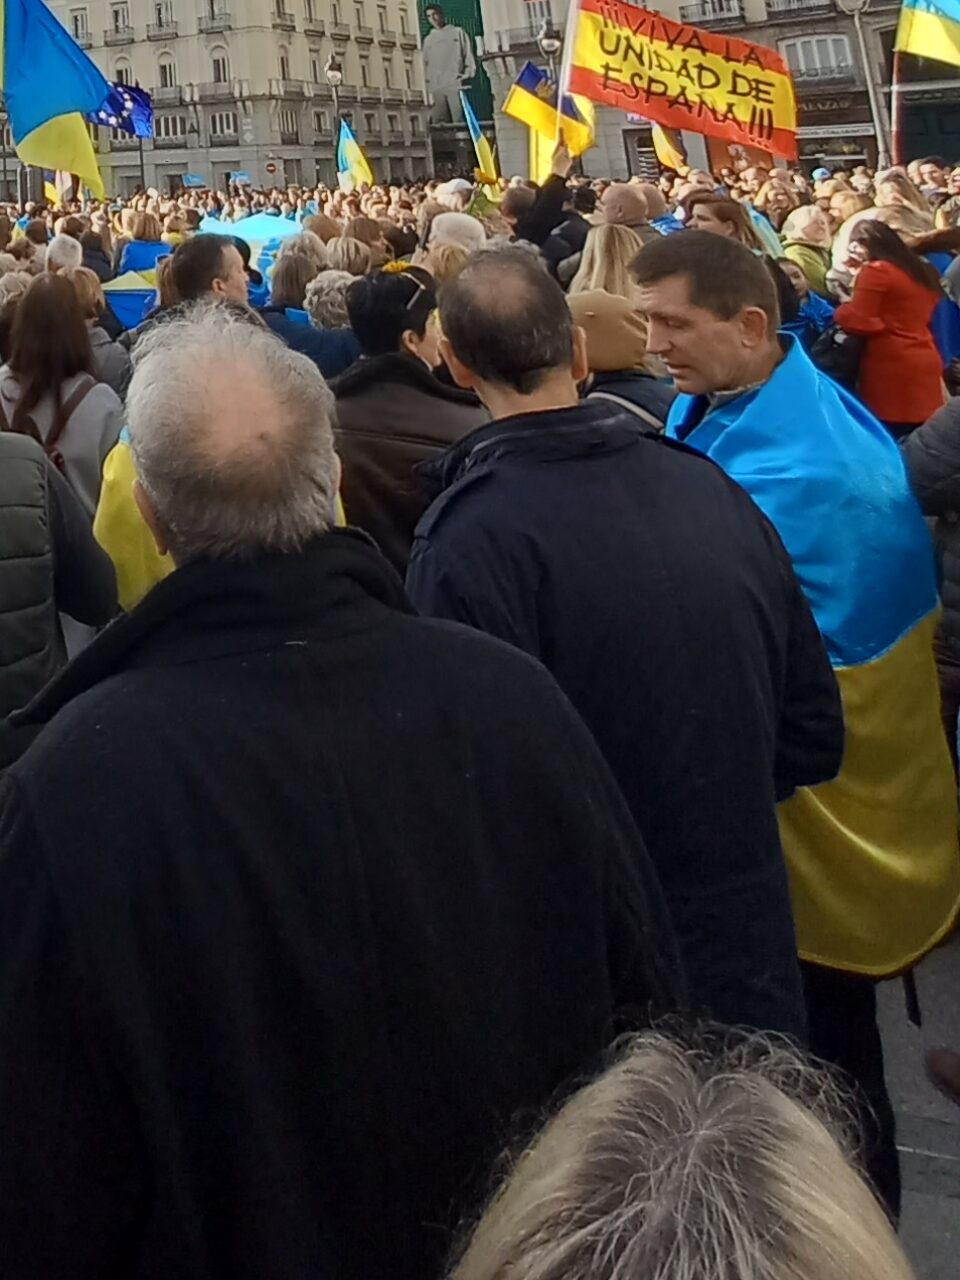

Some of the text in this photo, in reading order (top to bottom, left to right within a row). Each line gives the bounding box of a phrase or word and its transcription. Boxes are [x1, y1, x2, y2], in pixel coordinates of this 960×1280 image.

[599, 30, 776, 105] UNIDAD DE
[723, 40, 765, 71] LA
[797, 100, 850, 112] ALAZZO
